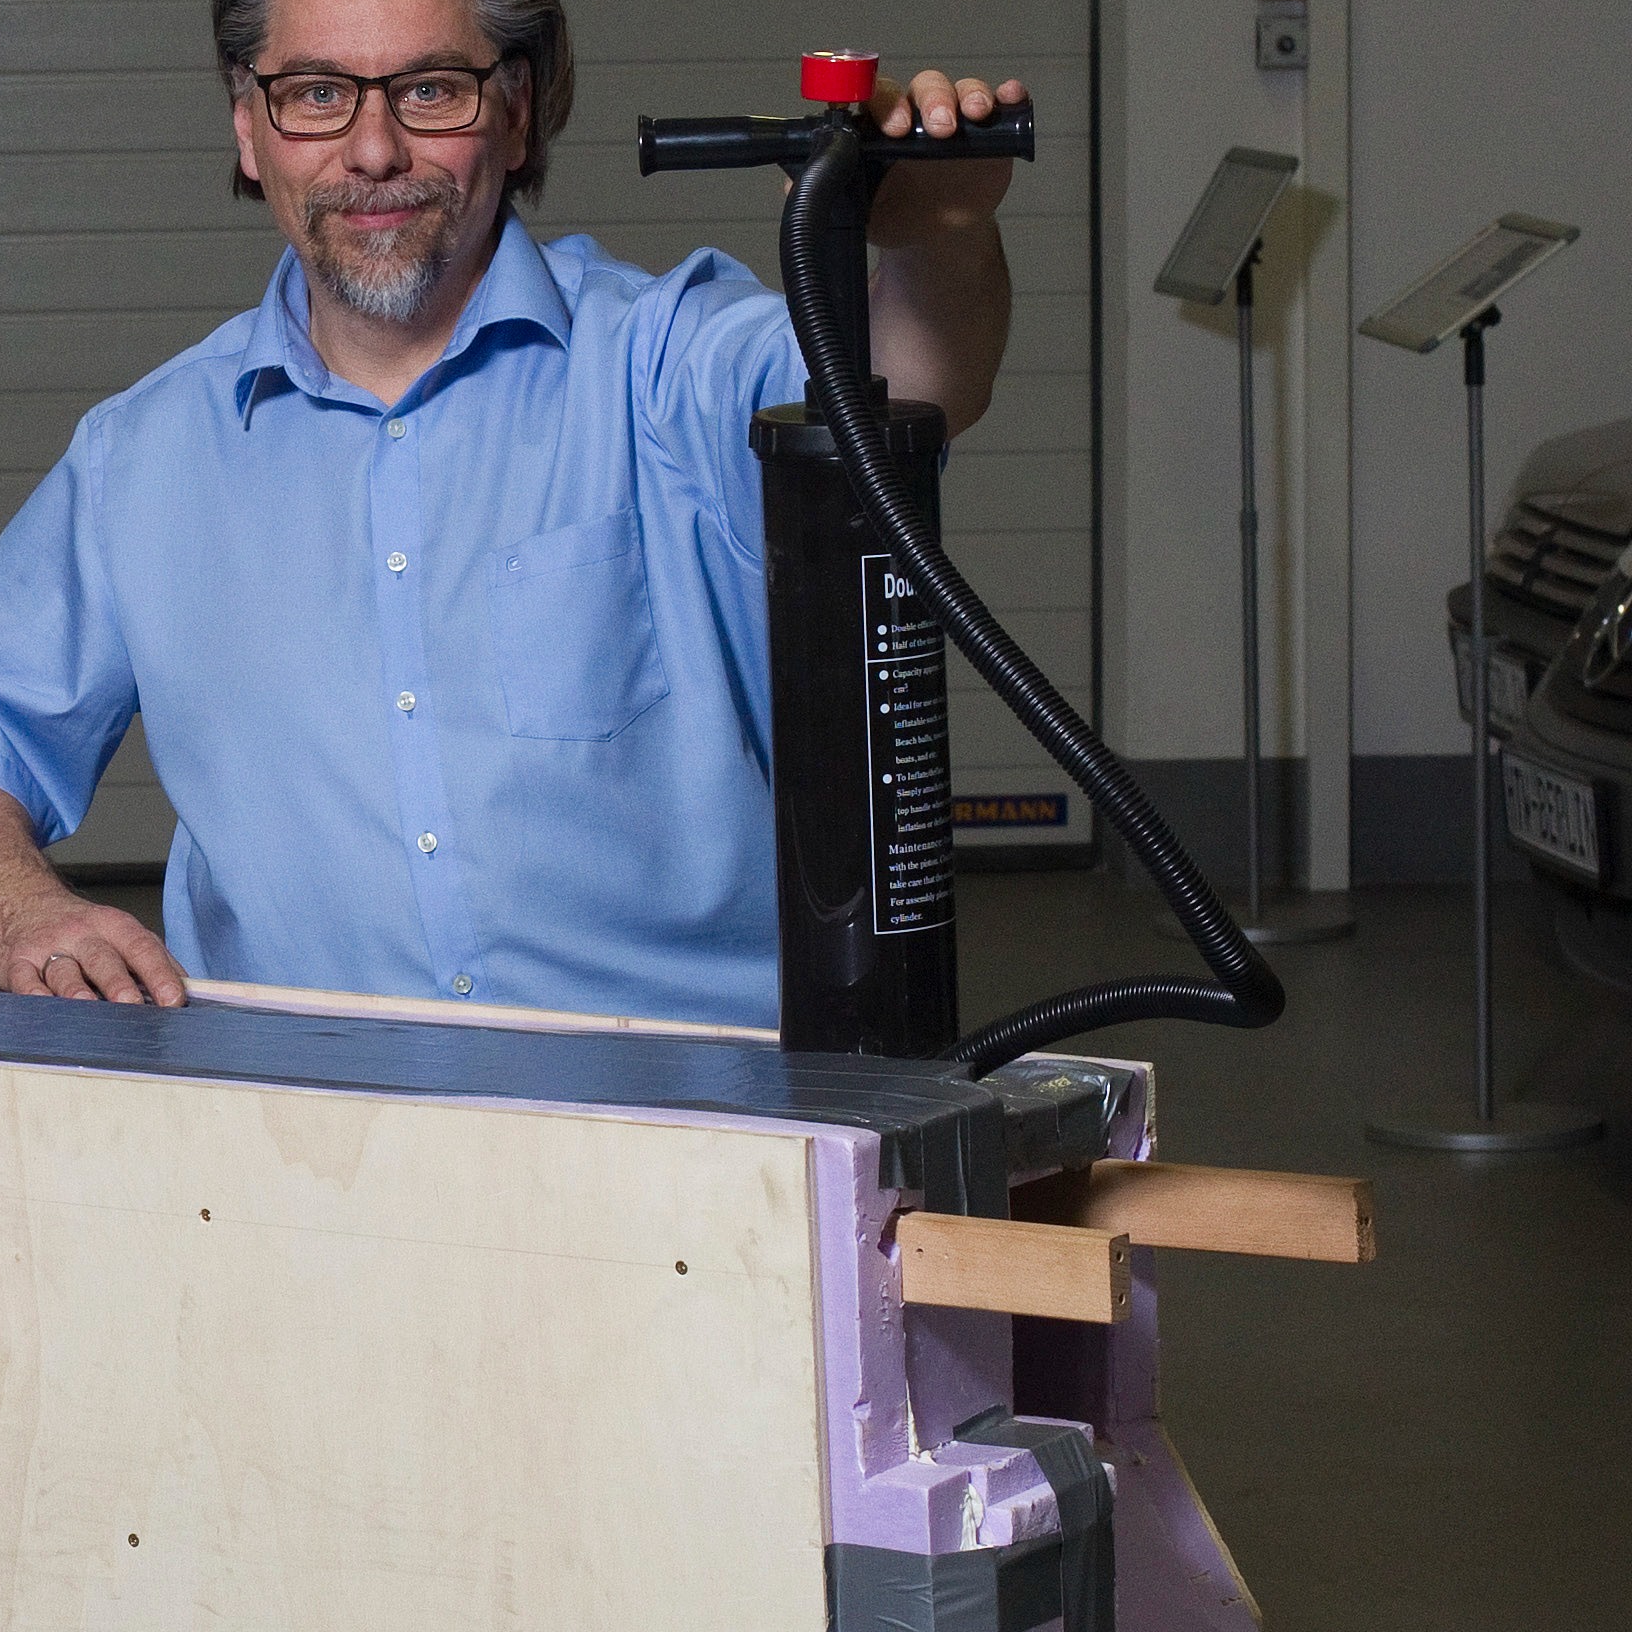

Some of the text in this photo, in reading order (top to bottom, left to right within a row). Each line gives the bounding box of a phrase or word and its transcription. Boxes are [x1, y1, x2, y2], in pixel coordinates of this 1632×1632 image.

[884, 572, 918, 599] Dou
[892, 640, 908, 650] Half
[909, 639, 916, 648] of
[892, 667, 922, 679] Capacity
[894, 701, 912, 712] Ideal
[913, 700, 922, 709] for
[896, 736, 917, 747] Beach
[896, 773, 906, 782] To
[896, 787, 922, 798] Simply
[898, 808, 910, 816] top
[910, 802, 931, 814] handle
[953, 800, 1057, 822] RMANN
[888, 862, 906, 872] with
[908, 861, 918, 870] the
[890, 880, 907, 890] take
[908, 878, 922, 888] care
[890, 897, 904, 906] For
[906, 892, 935, 905] assembly
[890, 912, 923, 924] cylinder.
